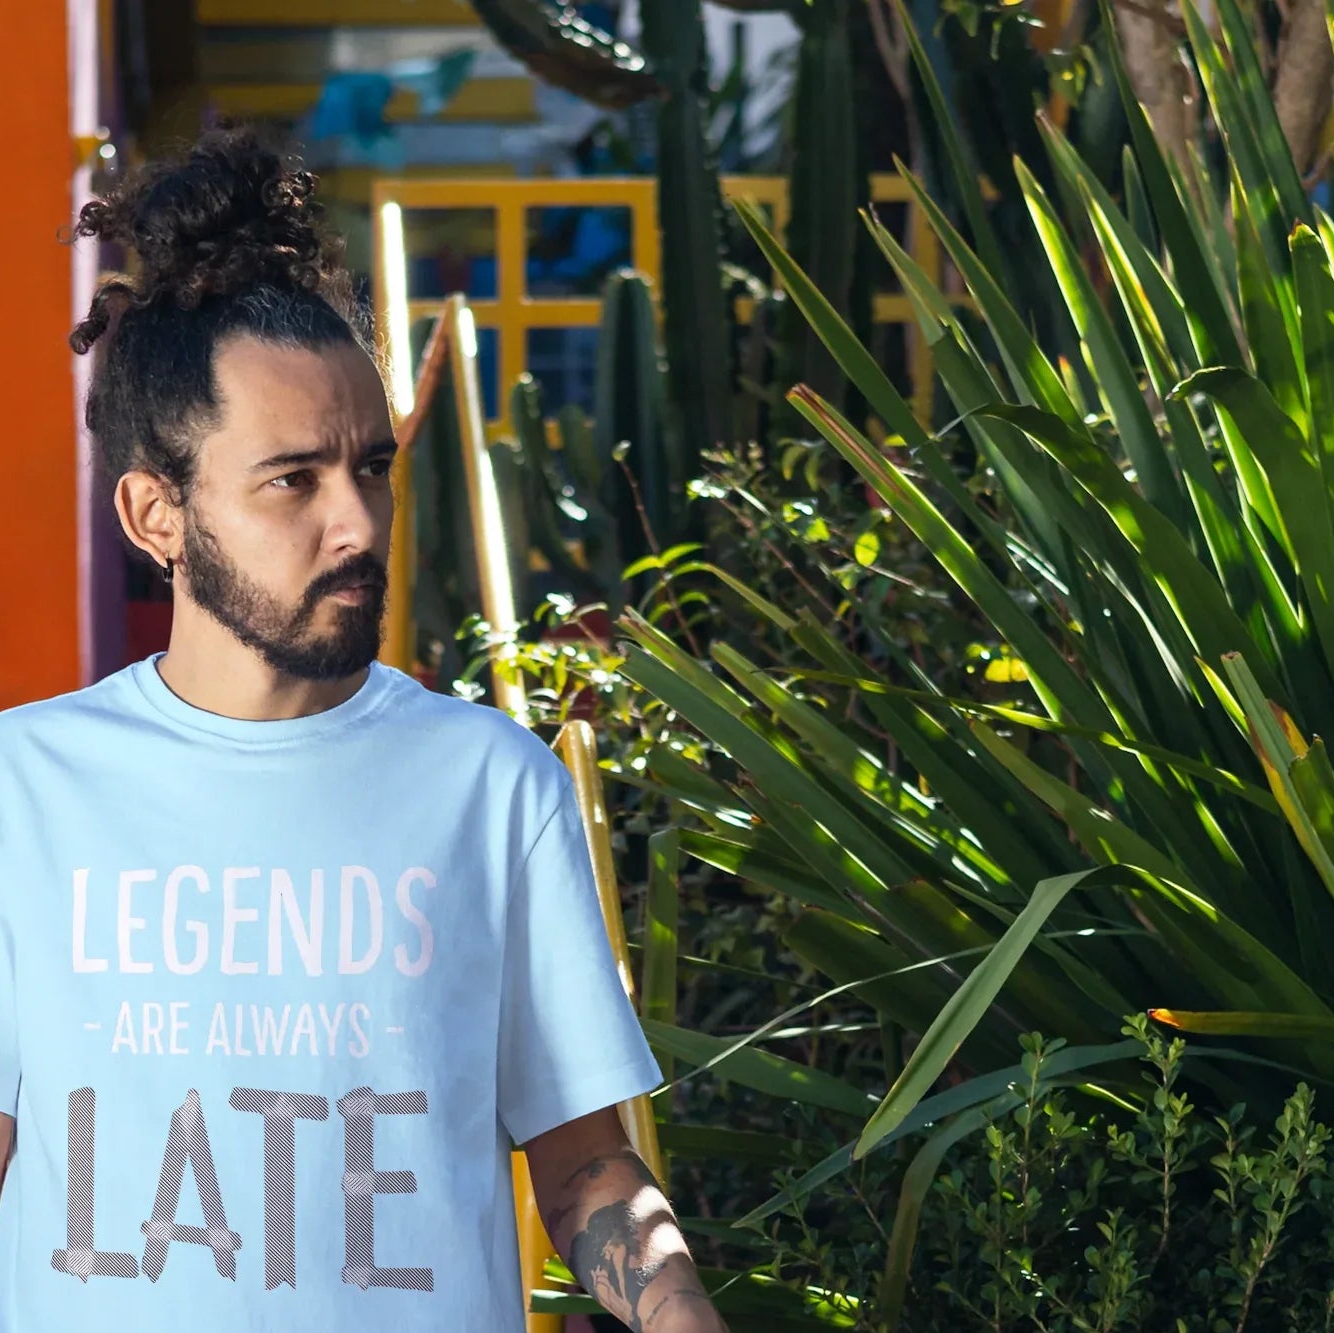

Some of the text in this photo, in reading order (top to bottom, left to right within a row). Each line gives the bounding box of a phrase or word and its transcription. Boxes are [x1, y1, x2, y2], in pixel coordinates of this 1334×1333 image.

[72, 865, 438, 977] LEGENDS
[112, 1000, 190, 1055] ARE
[206, 1002, 372, 1058] ALWAYS
[50, 1086, 435, 1292] LATE
